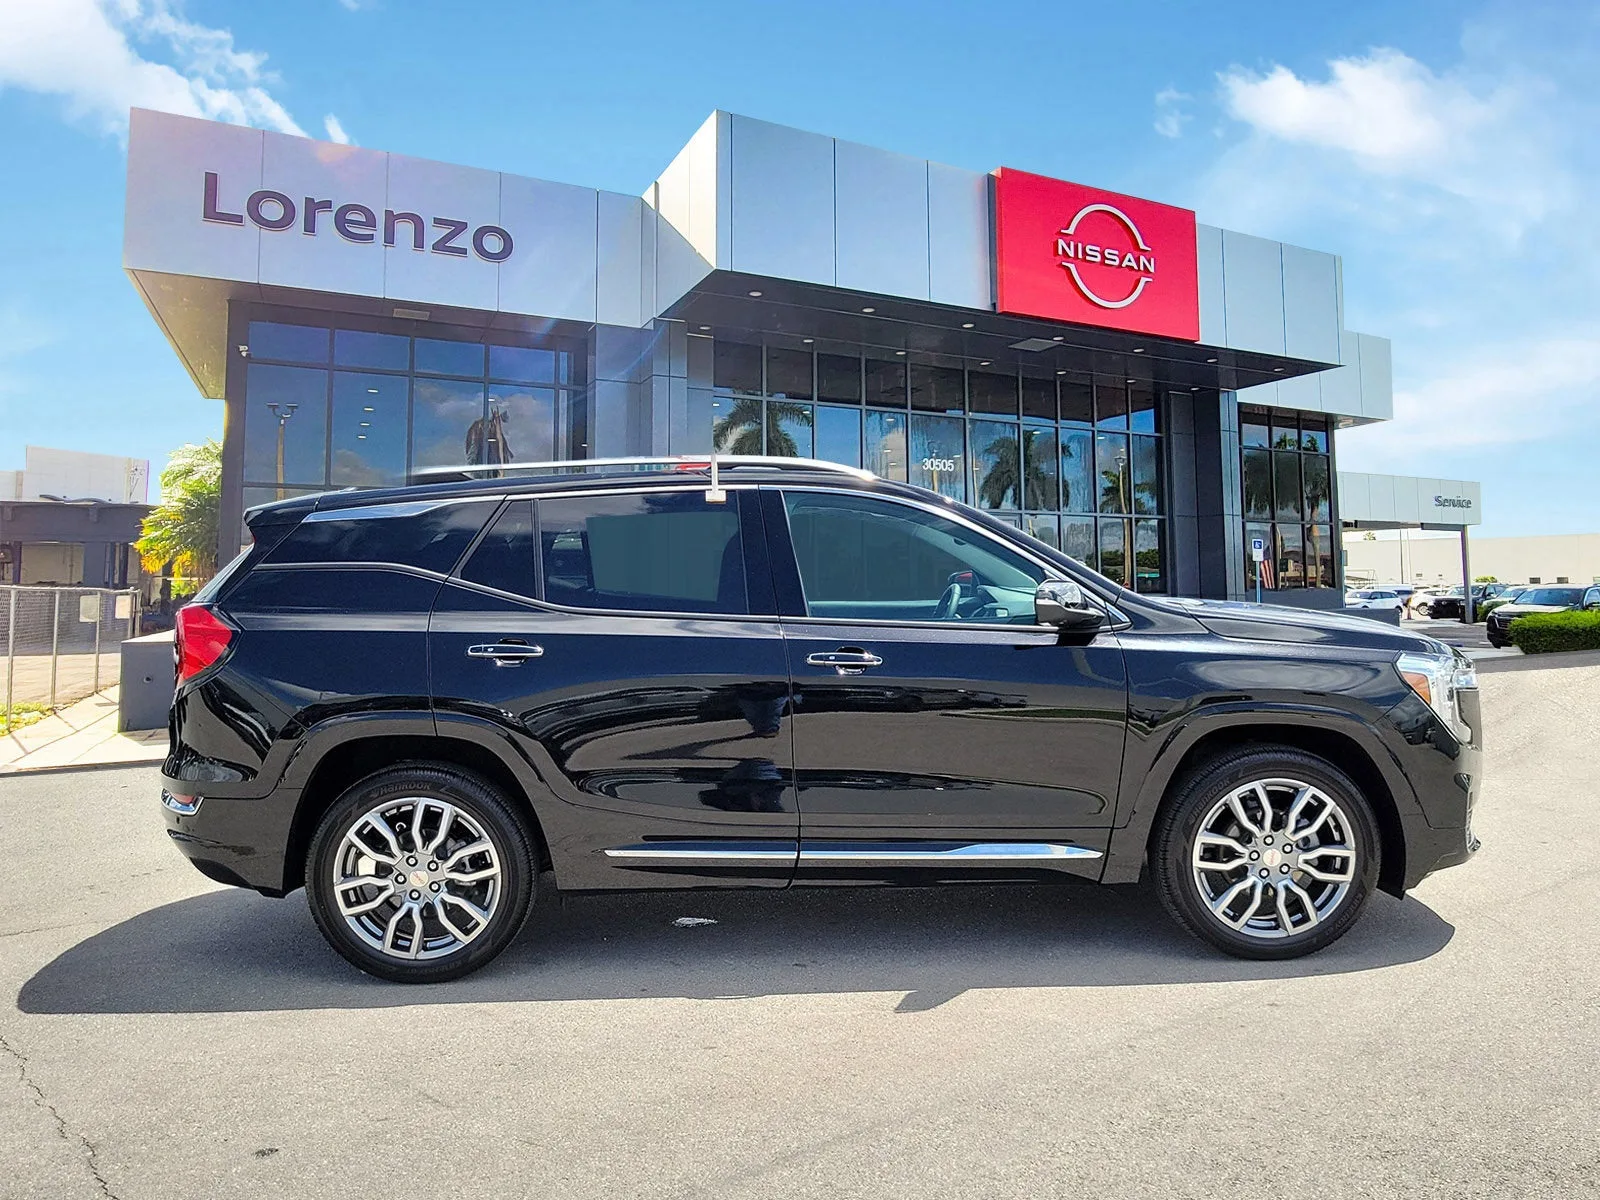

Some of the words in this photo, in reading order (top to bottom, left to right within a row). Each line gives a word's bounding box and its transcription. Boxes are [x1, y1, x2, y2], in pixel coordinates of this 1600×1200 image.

[203, 171, 514, 262] Lorenzo
[1057, 238, 1155, 273] NISSAN
[922, 458, 955, 471] 30505
[1434, 495, 1472, 508] Service
